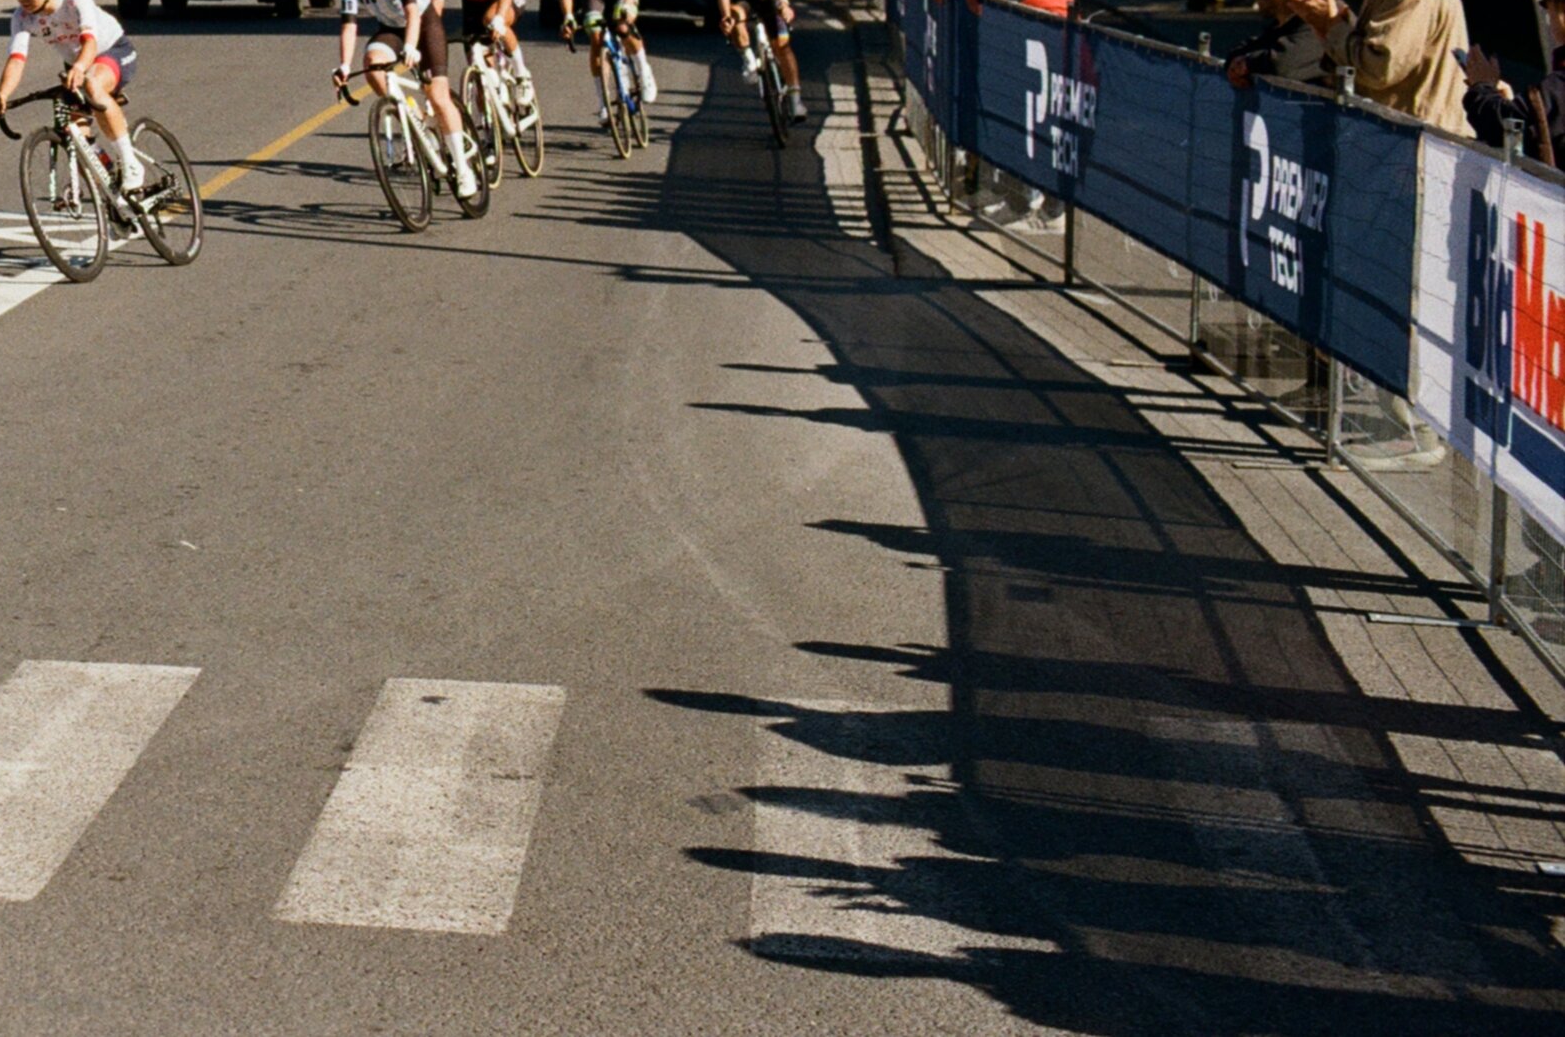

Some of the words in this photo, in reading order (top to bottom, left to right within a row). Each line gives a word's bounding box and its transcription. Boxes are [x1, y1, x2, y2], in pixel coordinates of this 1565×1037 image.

[1050, 72, 1097, 129] PREMIER
[1050, 125, 1079, 178] TECH
[1270, 155, 1329, 232] PREMIER
[1268, 225, 1305, 297] TECH
